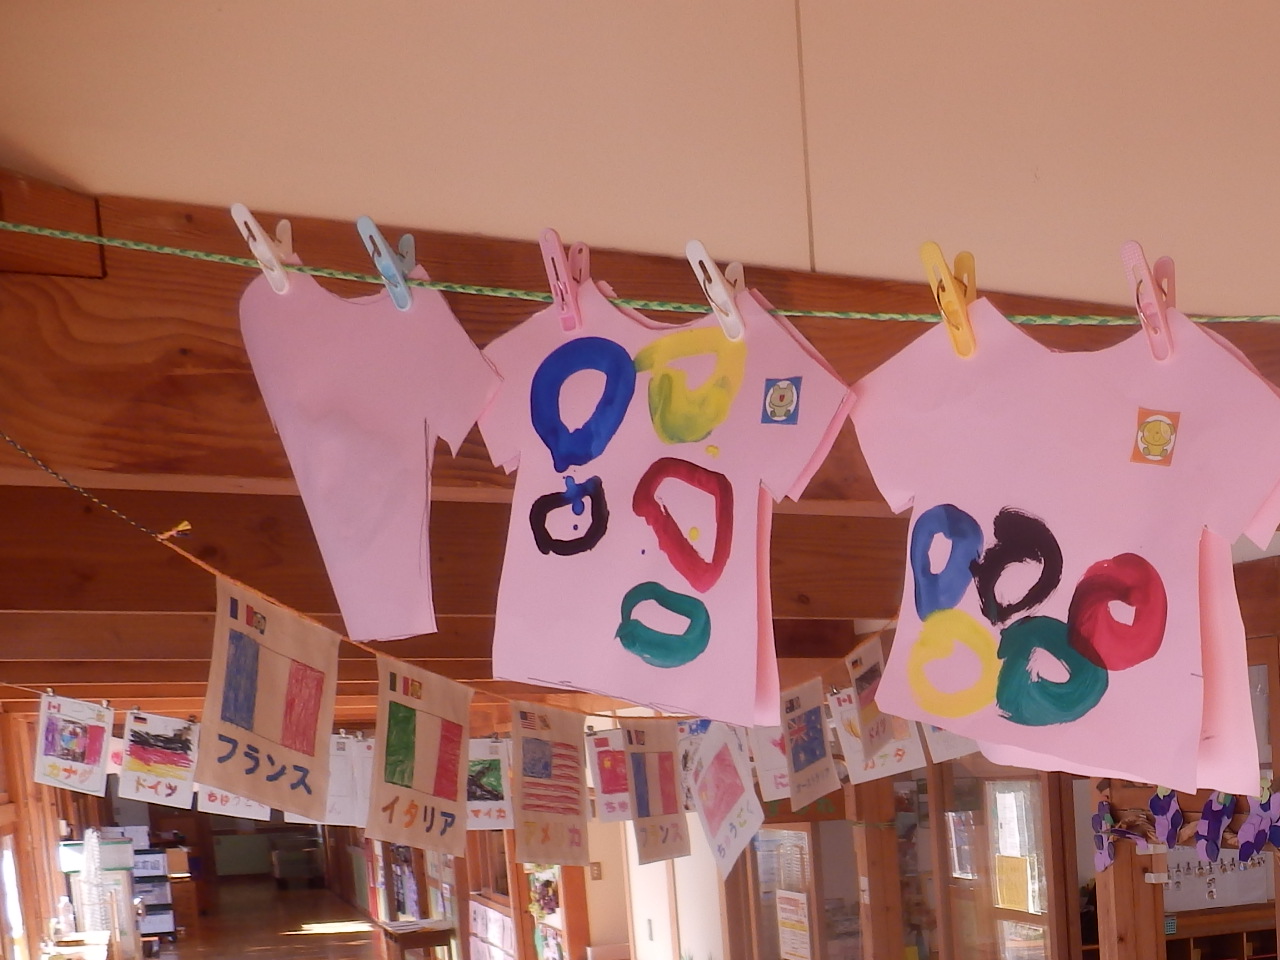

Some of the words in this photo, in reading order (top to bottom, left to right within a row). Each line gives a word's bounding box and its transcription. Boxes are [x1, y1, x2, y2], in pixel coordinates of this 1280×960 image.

[216, 733, 313, 795] フランス
[135, 776, 178, 798] ドイツ
[381, 795, 456, 837] イタリア
[640, 822, 684, 848] フランス
